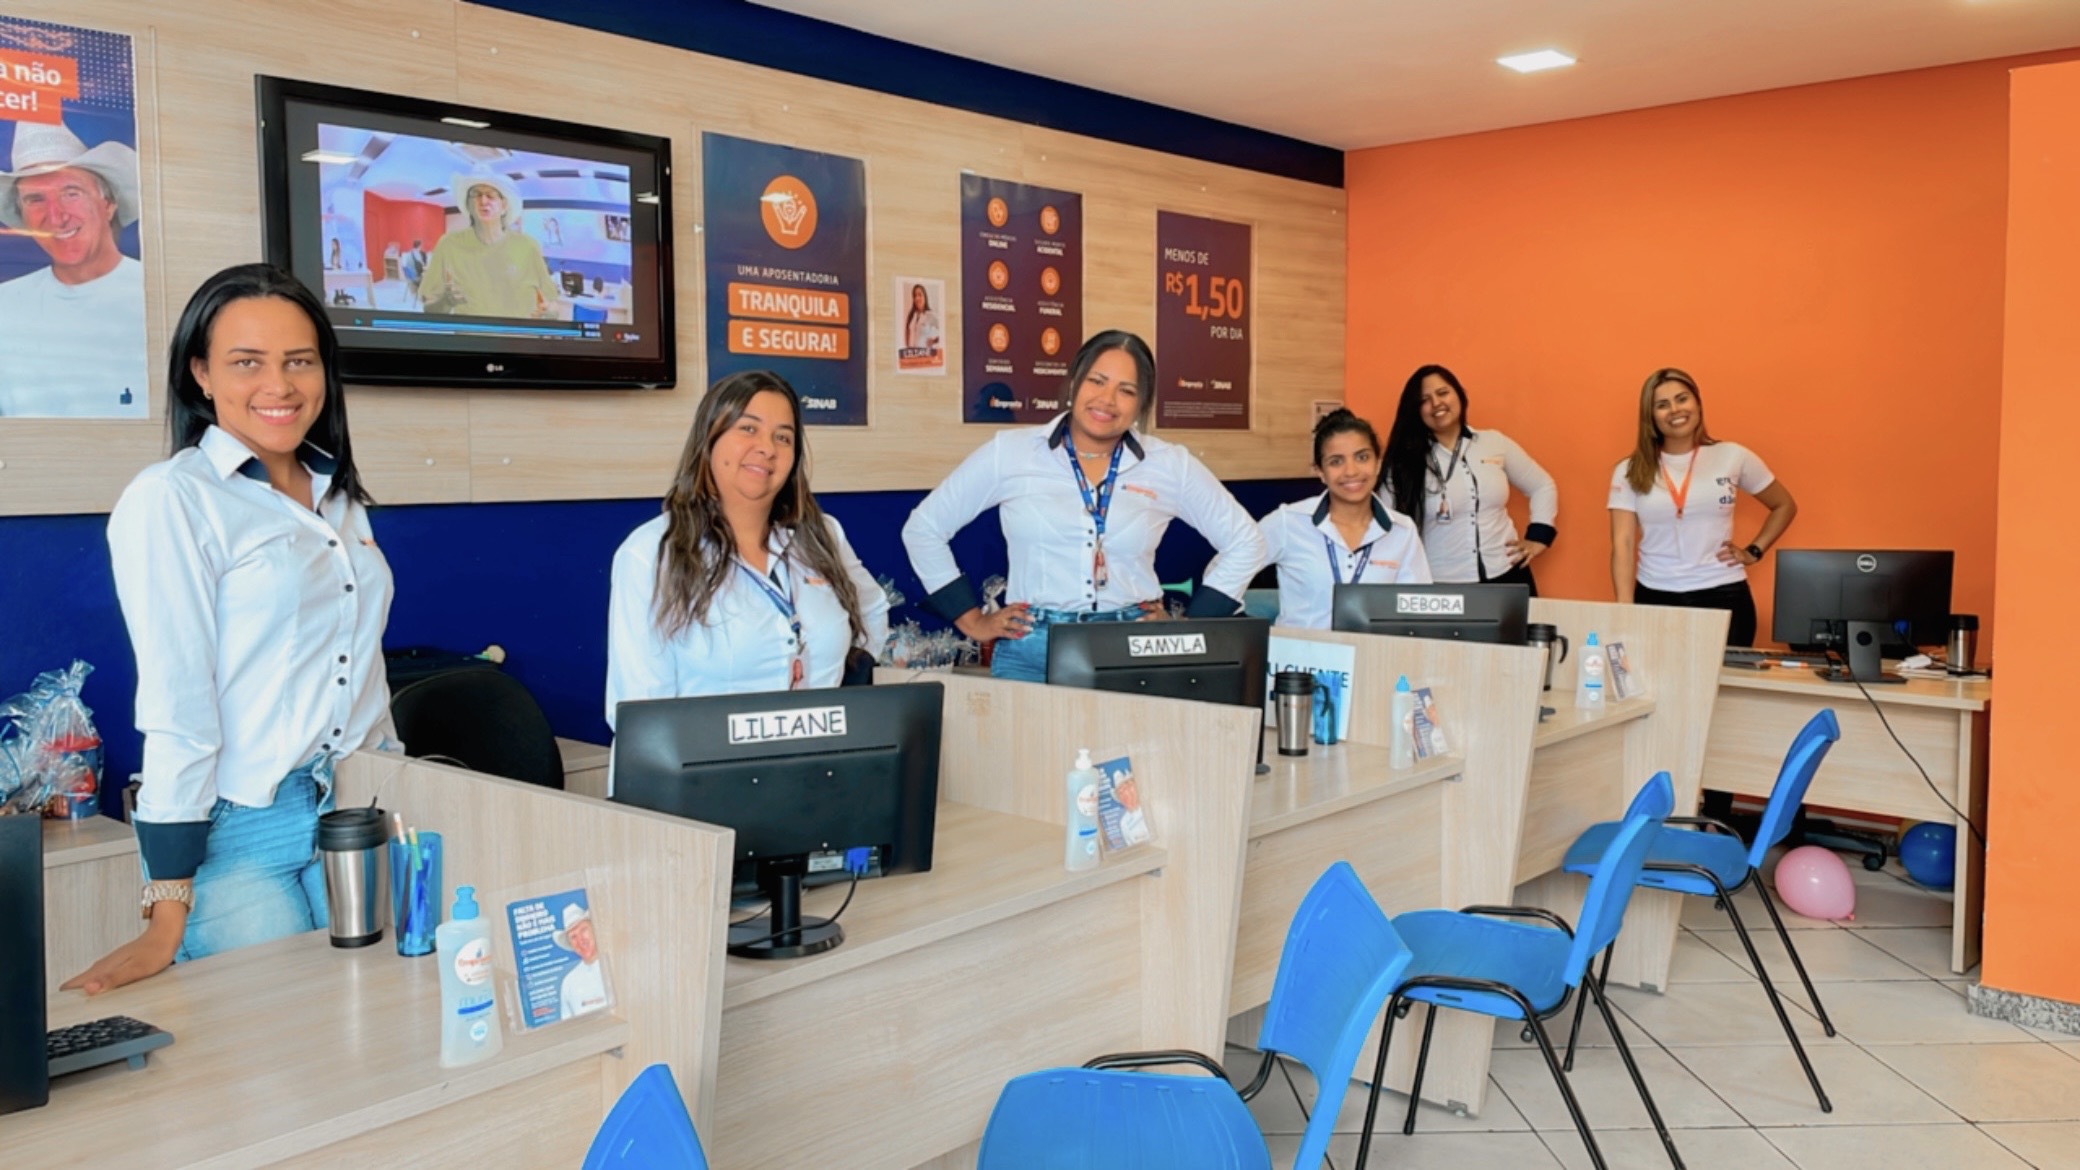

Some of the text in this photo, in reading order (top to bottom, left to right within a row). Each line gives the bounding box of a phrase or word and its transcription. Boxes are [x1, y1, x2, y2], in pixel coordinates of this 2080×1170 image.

[14, 61, 62, 86] não
[1165, 248, 1209, 266] MENOS DE
[737, 264, 839, 285] UMA APOSENTADORIA
[738, 289, 840, 318] TRANQUILA
[742, 327, 837, 353] E SEGURA!
[1210, 326, 1243, 340] POR DIA
[1400, 596, 1462, 612] DEBORA
[1131, 637, 1204, 654] SAMYLA
[731, 710, 842, 741] LILIANE
